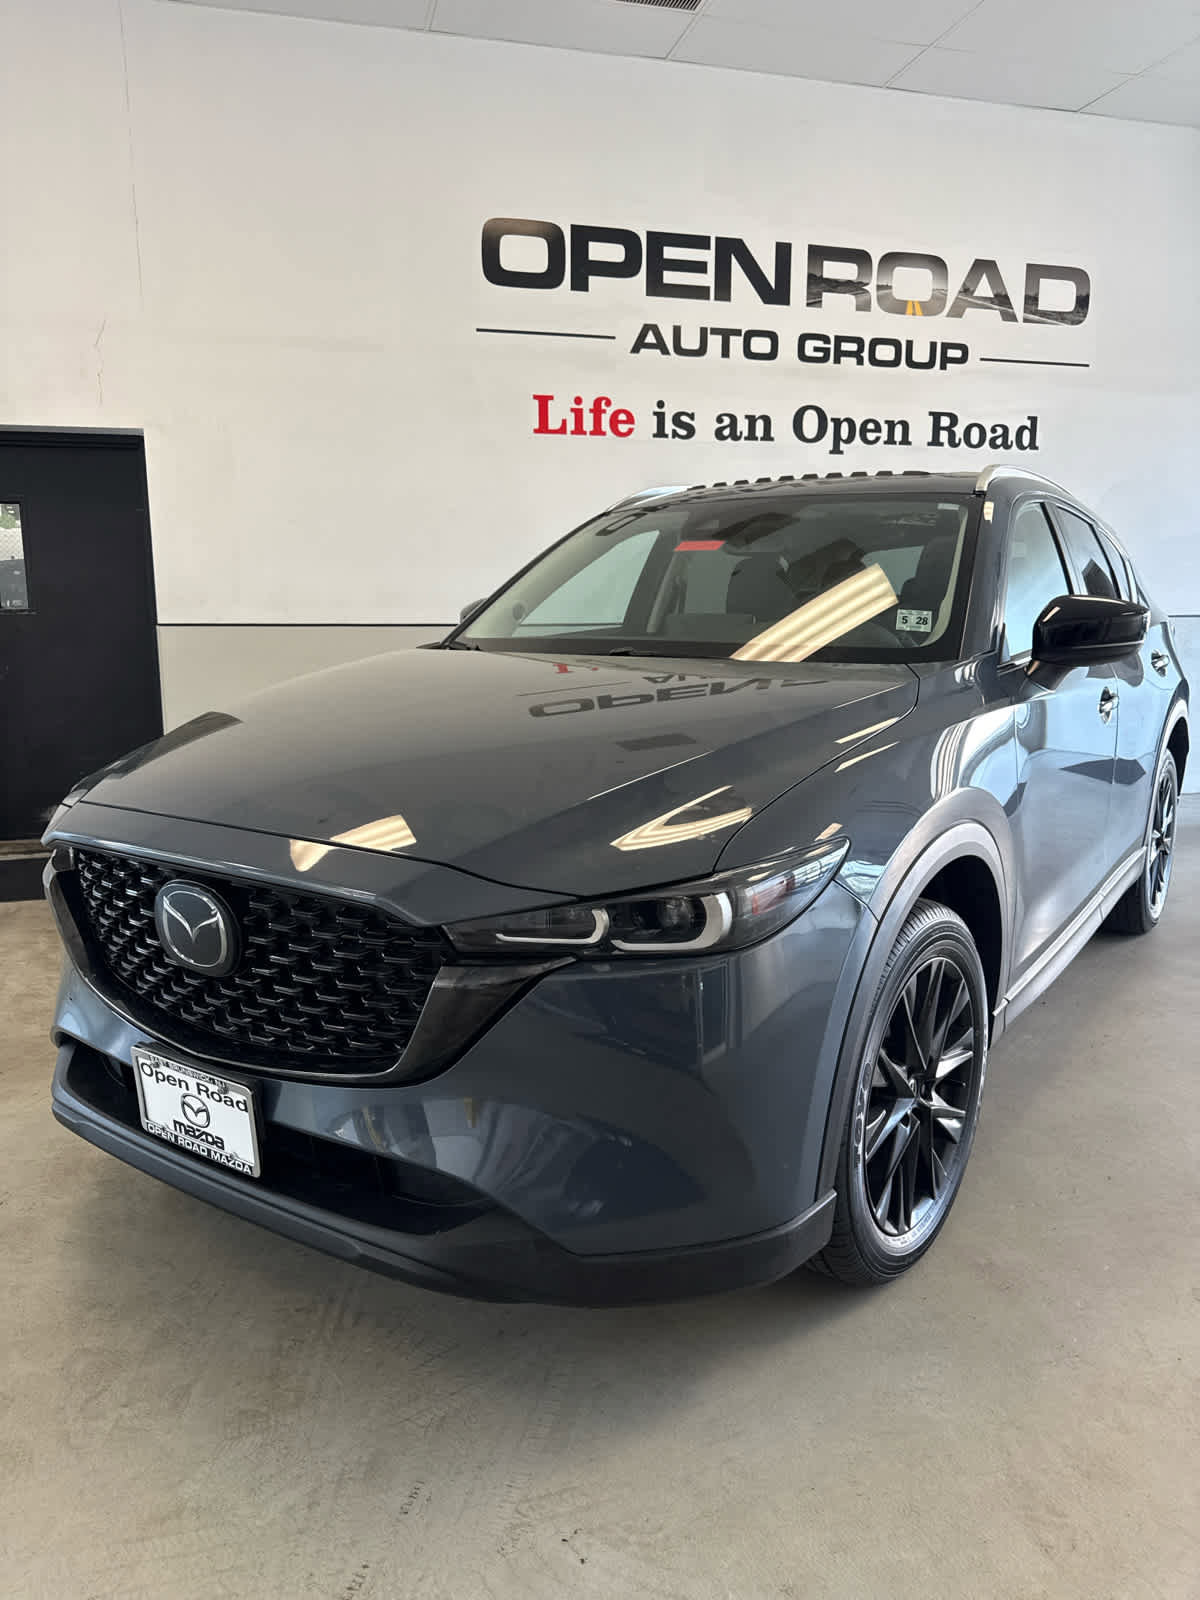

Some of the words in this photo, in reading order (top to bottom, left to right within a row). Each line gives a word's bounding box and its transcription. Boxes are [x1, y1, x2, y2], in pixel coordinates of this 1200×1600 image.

[481, 217, 793, 307] OPEN
[805, 243, 1091, 326] ROAD
[629, 323, 779, 362] AUTO
[797, 332, 969, 371] GROUP
[532, 394, 636, 438] Life
[652, 399, 696, 441] is
[714, 412, 775, 442] an
[792, 404, 913, 455] Open
[926, 410, 1039, 451] Road
[901, 615, 909, 625] 5
[915, 616, 929, 626] 28
[140, 1062, 190, 1091] Open
[195, 1082, 249, 1113] Road
[146, 1122, 176, 1143] OPEN
[178, 1138, 208, 1157] ROAD
[211, 1151, 252, 1175] MAZDA
